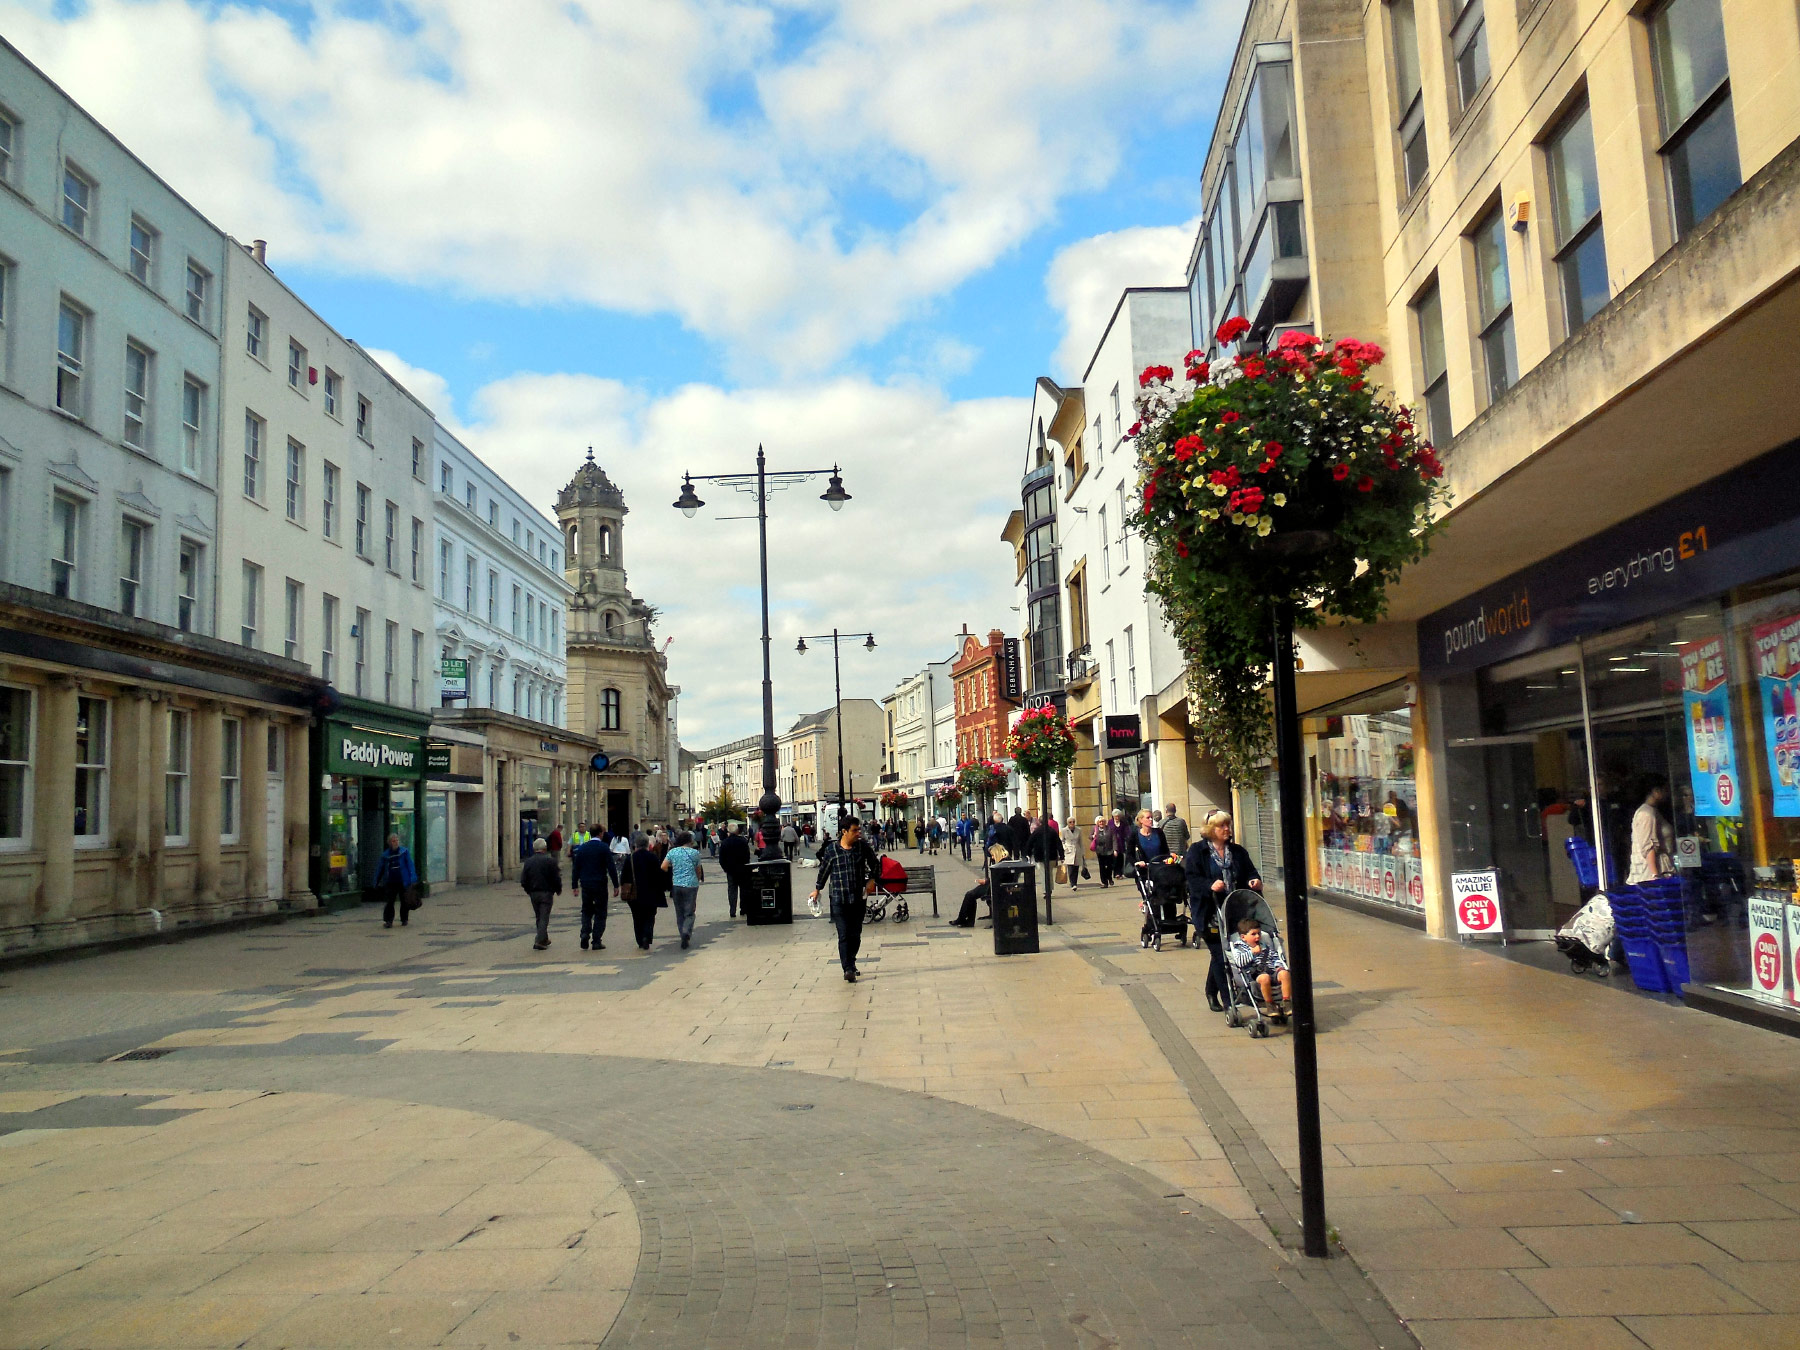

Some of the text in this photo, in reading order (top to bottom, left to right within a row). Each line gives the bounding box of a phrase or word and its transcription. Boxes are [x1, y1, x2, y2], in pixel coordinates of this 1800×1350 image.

[1588, 525, 1709, 595] everything £1
[1445, 588, 1531, 663] poundworld
[1756, 632, 1778, 652] YOU
[1008, 641, 1017, 694] DEBENHAMS
[1682, 650, 1698, 669] YOU
[1110, 727, 1136, 738] hmv
[343, 738, 414, 767] Paddy Power
[1455, 875, 1493, 884] AMAZING
[1457, 883, 1492, 892] VALUE!
[1464, 900, 1490, 908] ONLY
[1751, 903, 1782, 918] AMAZING
[1466, 908, 1490, 925] £1
[1758, 941, 1777, 955] ONLY
[1760, 954, 1775, 983] £1
